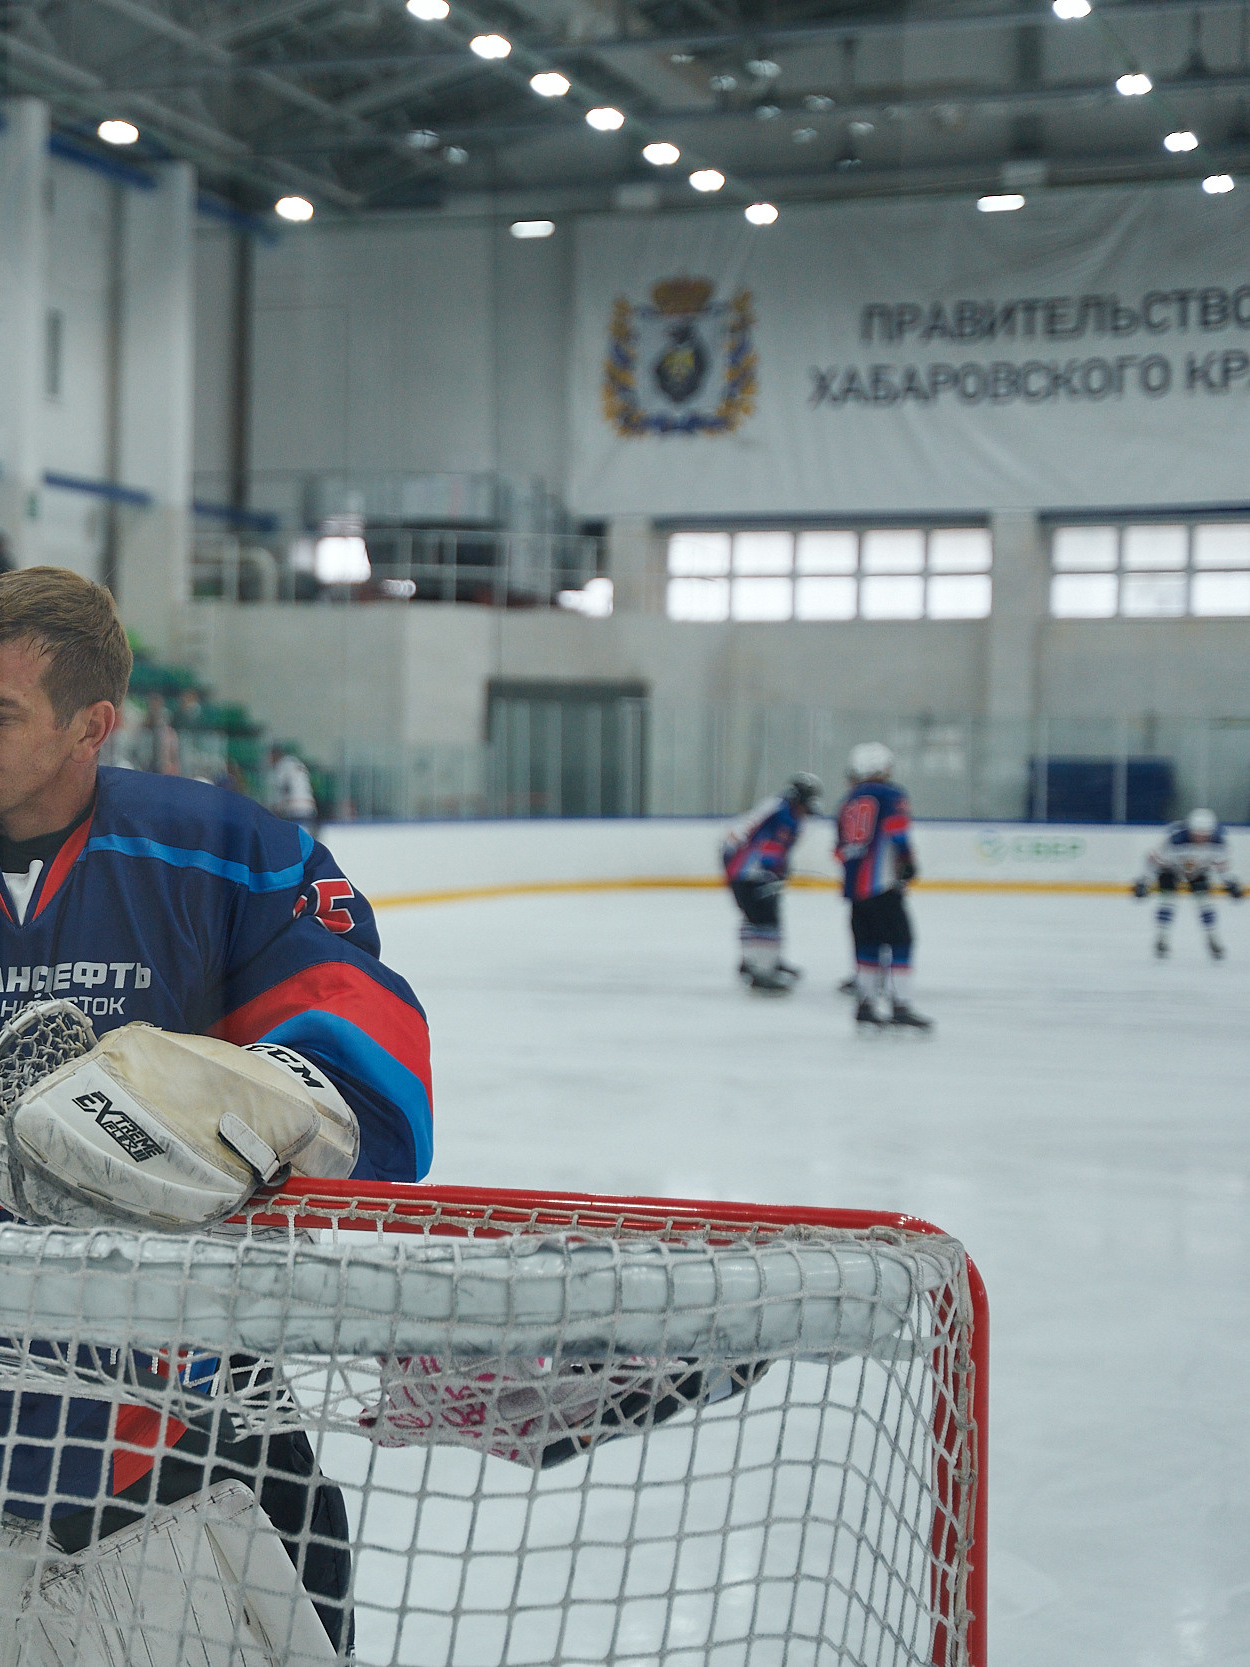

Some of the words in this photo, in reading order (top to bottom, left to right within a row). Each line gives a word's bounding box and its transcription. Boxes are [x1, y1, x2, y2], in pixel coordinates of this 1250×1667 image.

[812, 353, 1171, 407] ХАБАРОВСКОГО
[1186, 349, 1250, 391] КР
[245, 1045, 325, 1089] CCM
[71, 1091, 165, 1158] EXTREME
